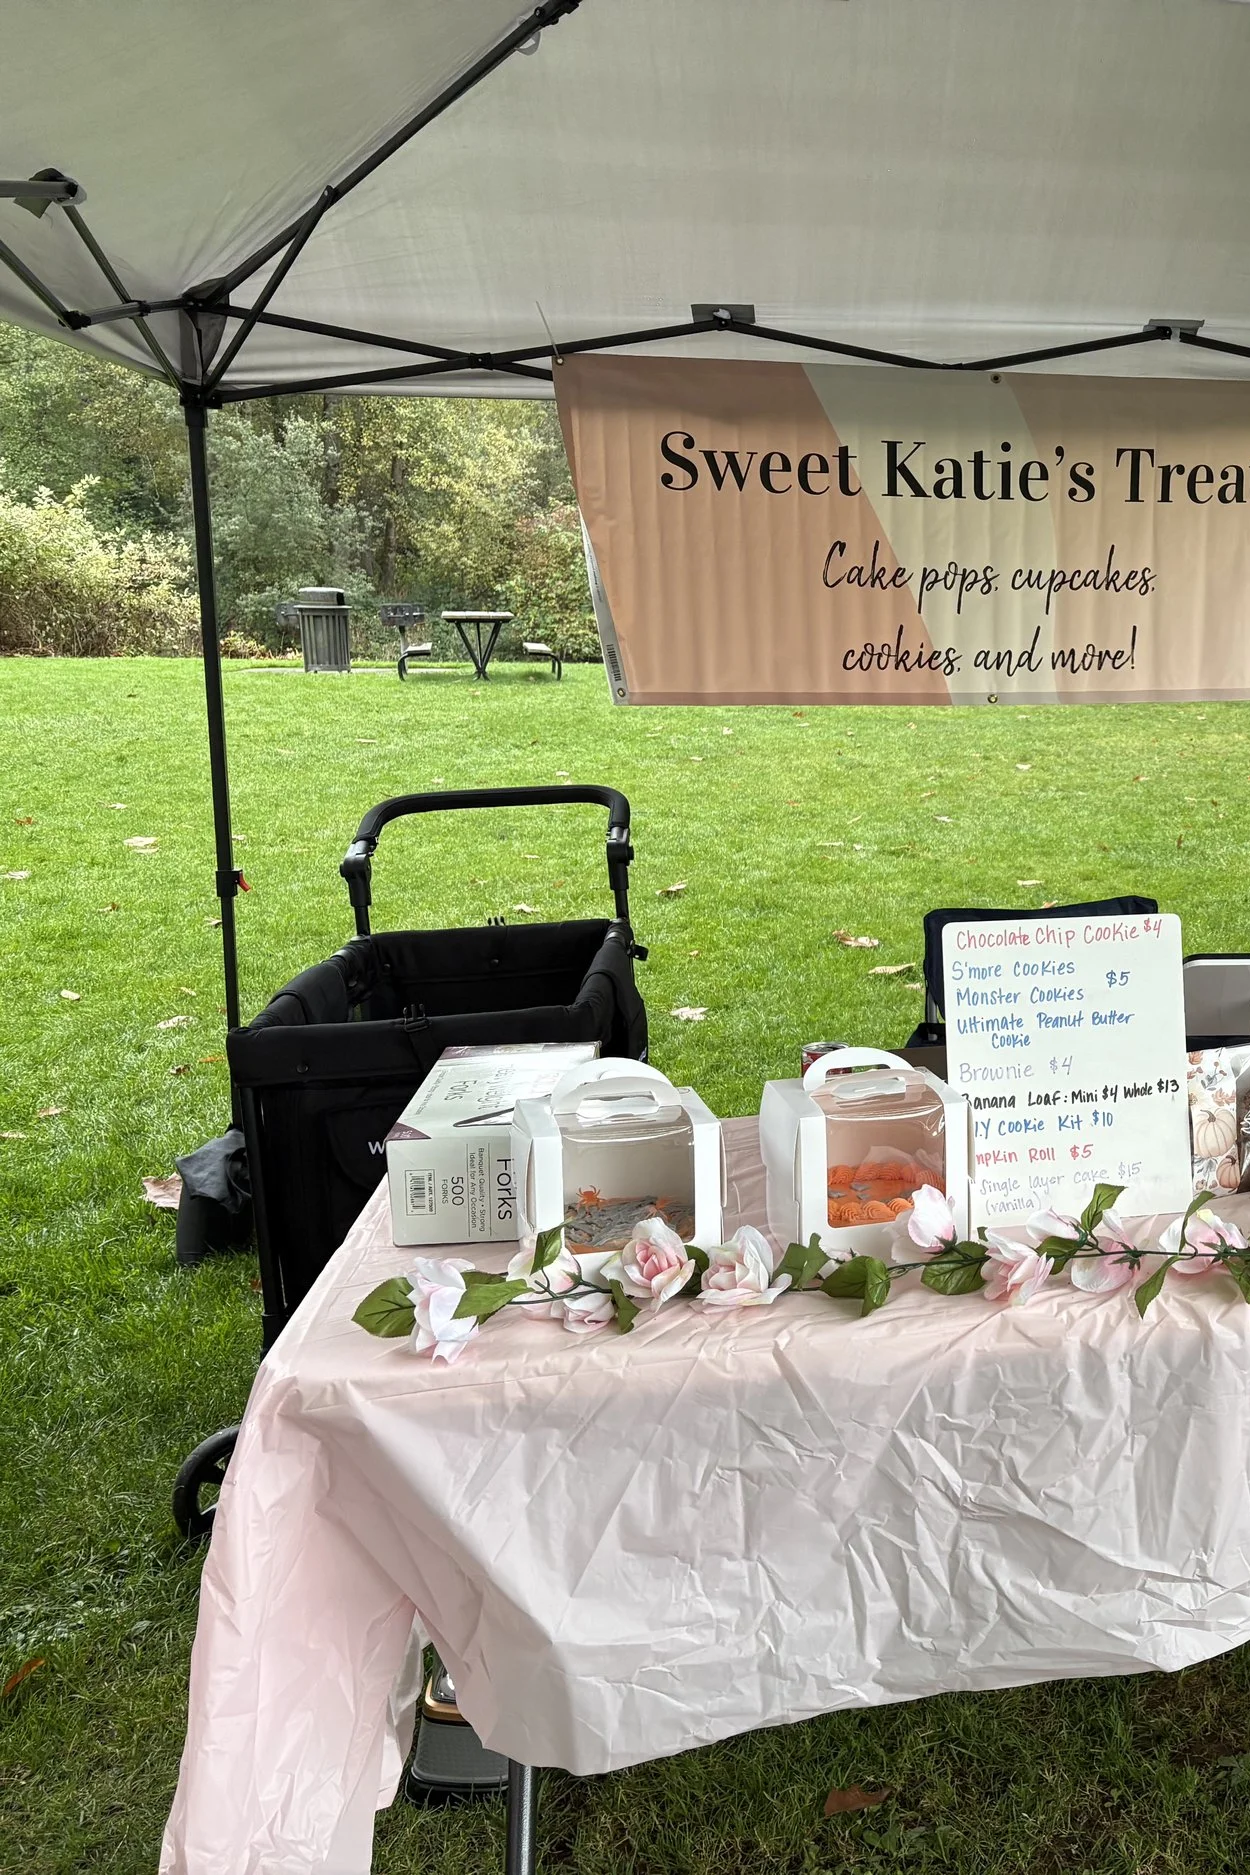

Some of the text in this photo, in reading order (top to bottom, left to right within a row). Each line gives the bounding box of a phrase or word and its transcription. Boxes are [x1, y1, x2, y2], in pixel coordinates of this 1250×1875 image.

[660, 430, 862, 497] Sweet
[881, 439, 1097, 505] Katie's
[822, 539, 914, 589] Cake
[973, 625, 1044, 677] and
[1051, 625, 1138, 675] more!
[956, 926, 1031, 950] Chocolate
[1036, 924, 1076, 948] Chip
[1143, 917, 1162, 938] $4
[951, 960, 1002, 981] S'more
[1105, 969, 1131, 988] $5
[956, 987, 1021, 1007] Monster
[957, 1009, 1136, 1035] Ultimate Peanut Butter
[959, 1055, 1073, 1083] Brownie $4
[1101, 1084, 1118, 1103] $4
[1156, 1077, 1180, 1094] $13
[1058, 1114, 1083, 1131] Kit
[1091, 1108, 1114, 1127] $10
[1028, 1146, 1055, 1163] Roll
[1069, 1143, 1094, 1161] $5
[1118, 1161, 1142, 1179] $15
[441, 1178, 449, 1205] FORKS
[451, 1176, 465, 1206] 500
[470, 1197, 478, 1229] Occasion
[479, 1209, 487, 1232] Strong
